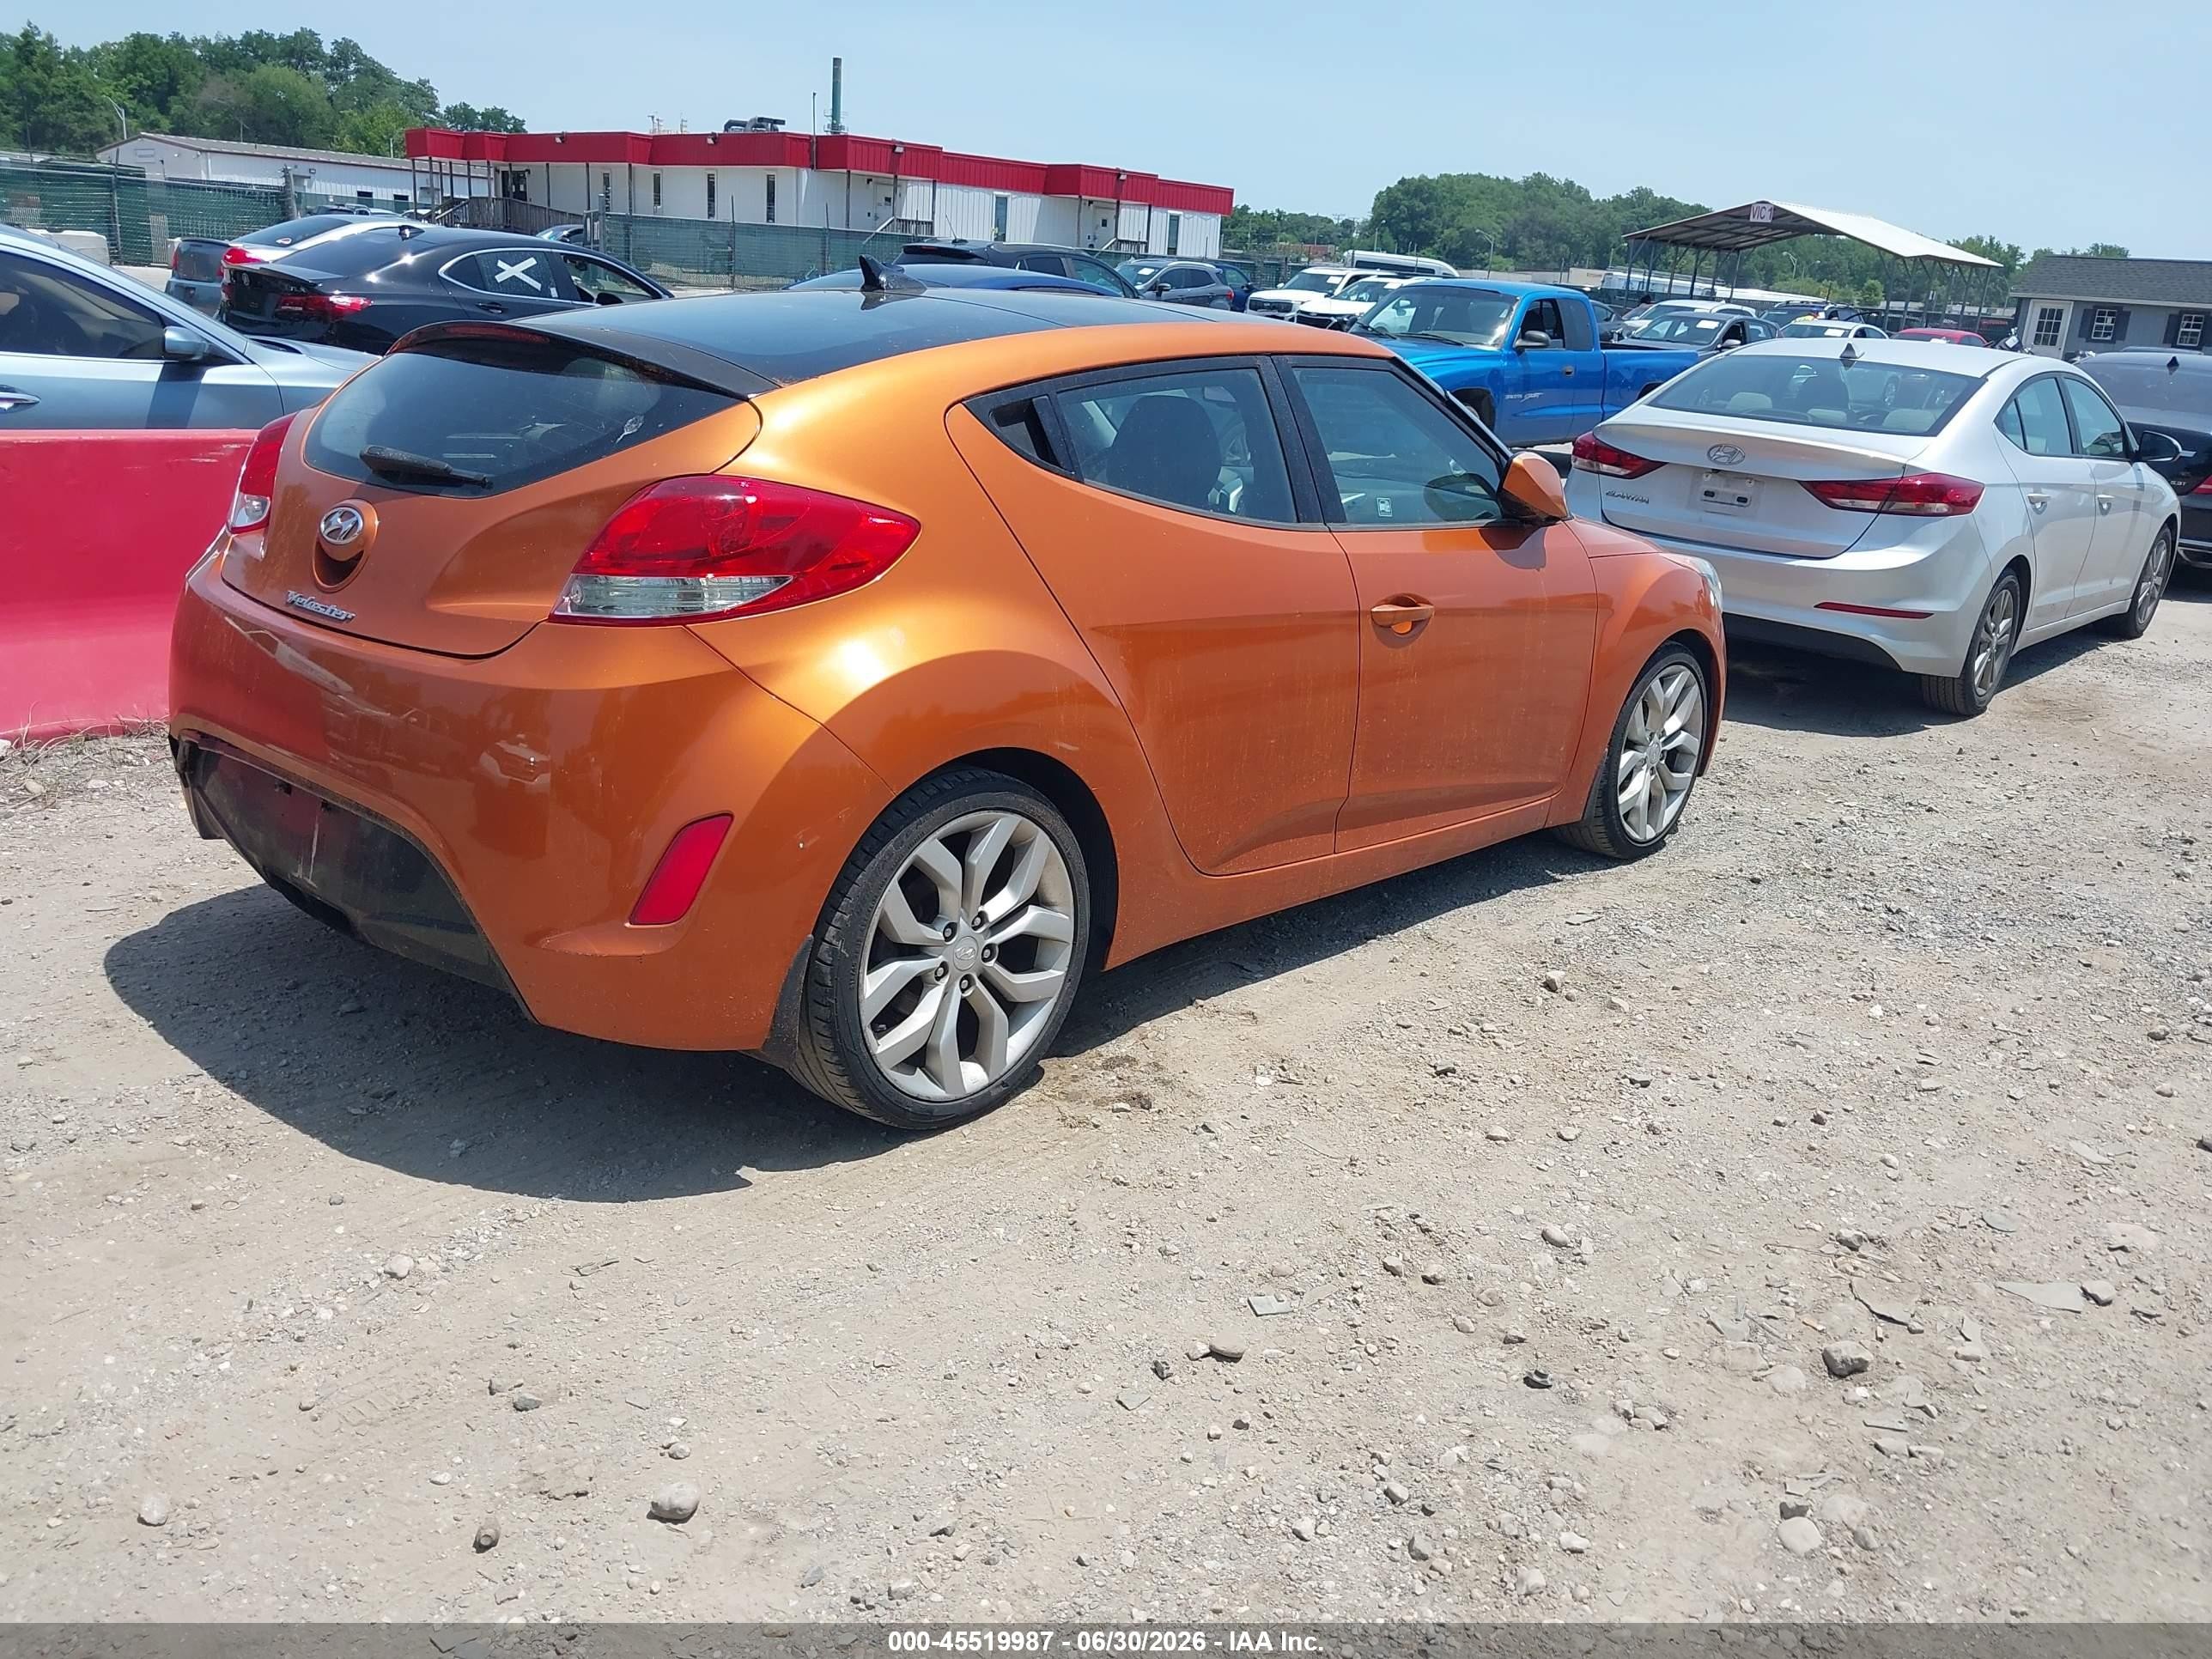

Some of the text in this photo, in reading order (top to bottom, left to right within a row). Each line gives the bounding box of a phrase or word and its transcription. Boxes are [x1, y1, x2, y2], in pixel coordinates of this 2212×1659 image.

[1752, 205, 1773, 221] VIC 1
[286, 590, 356, 621] Veloster
